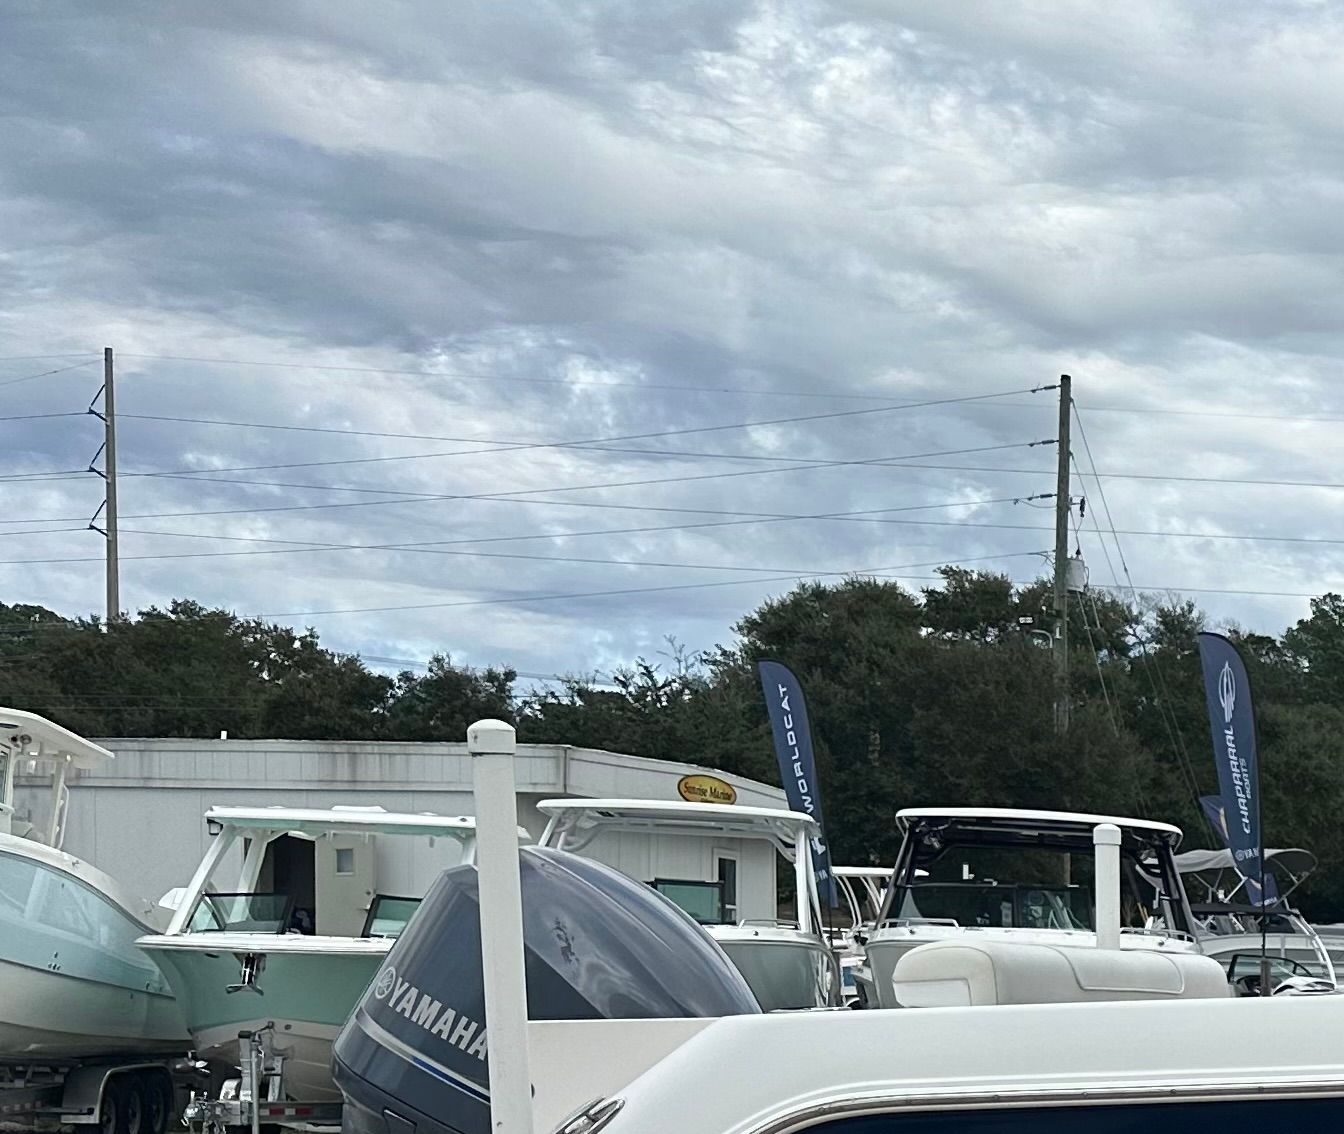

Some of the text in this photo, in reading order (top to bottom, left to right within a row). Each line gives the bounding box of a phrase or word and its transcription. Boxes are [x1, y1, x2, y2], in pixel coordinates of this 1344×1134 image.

[778, 683, 814, 814] WORLDCAT
[1224, 725, 1251, 834] CHAPARRAL
[388, 976, 488, 1061] YAMAHA
